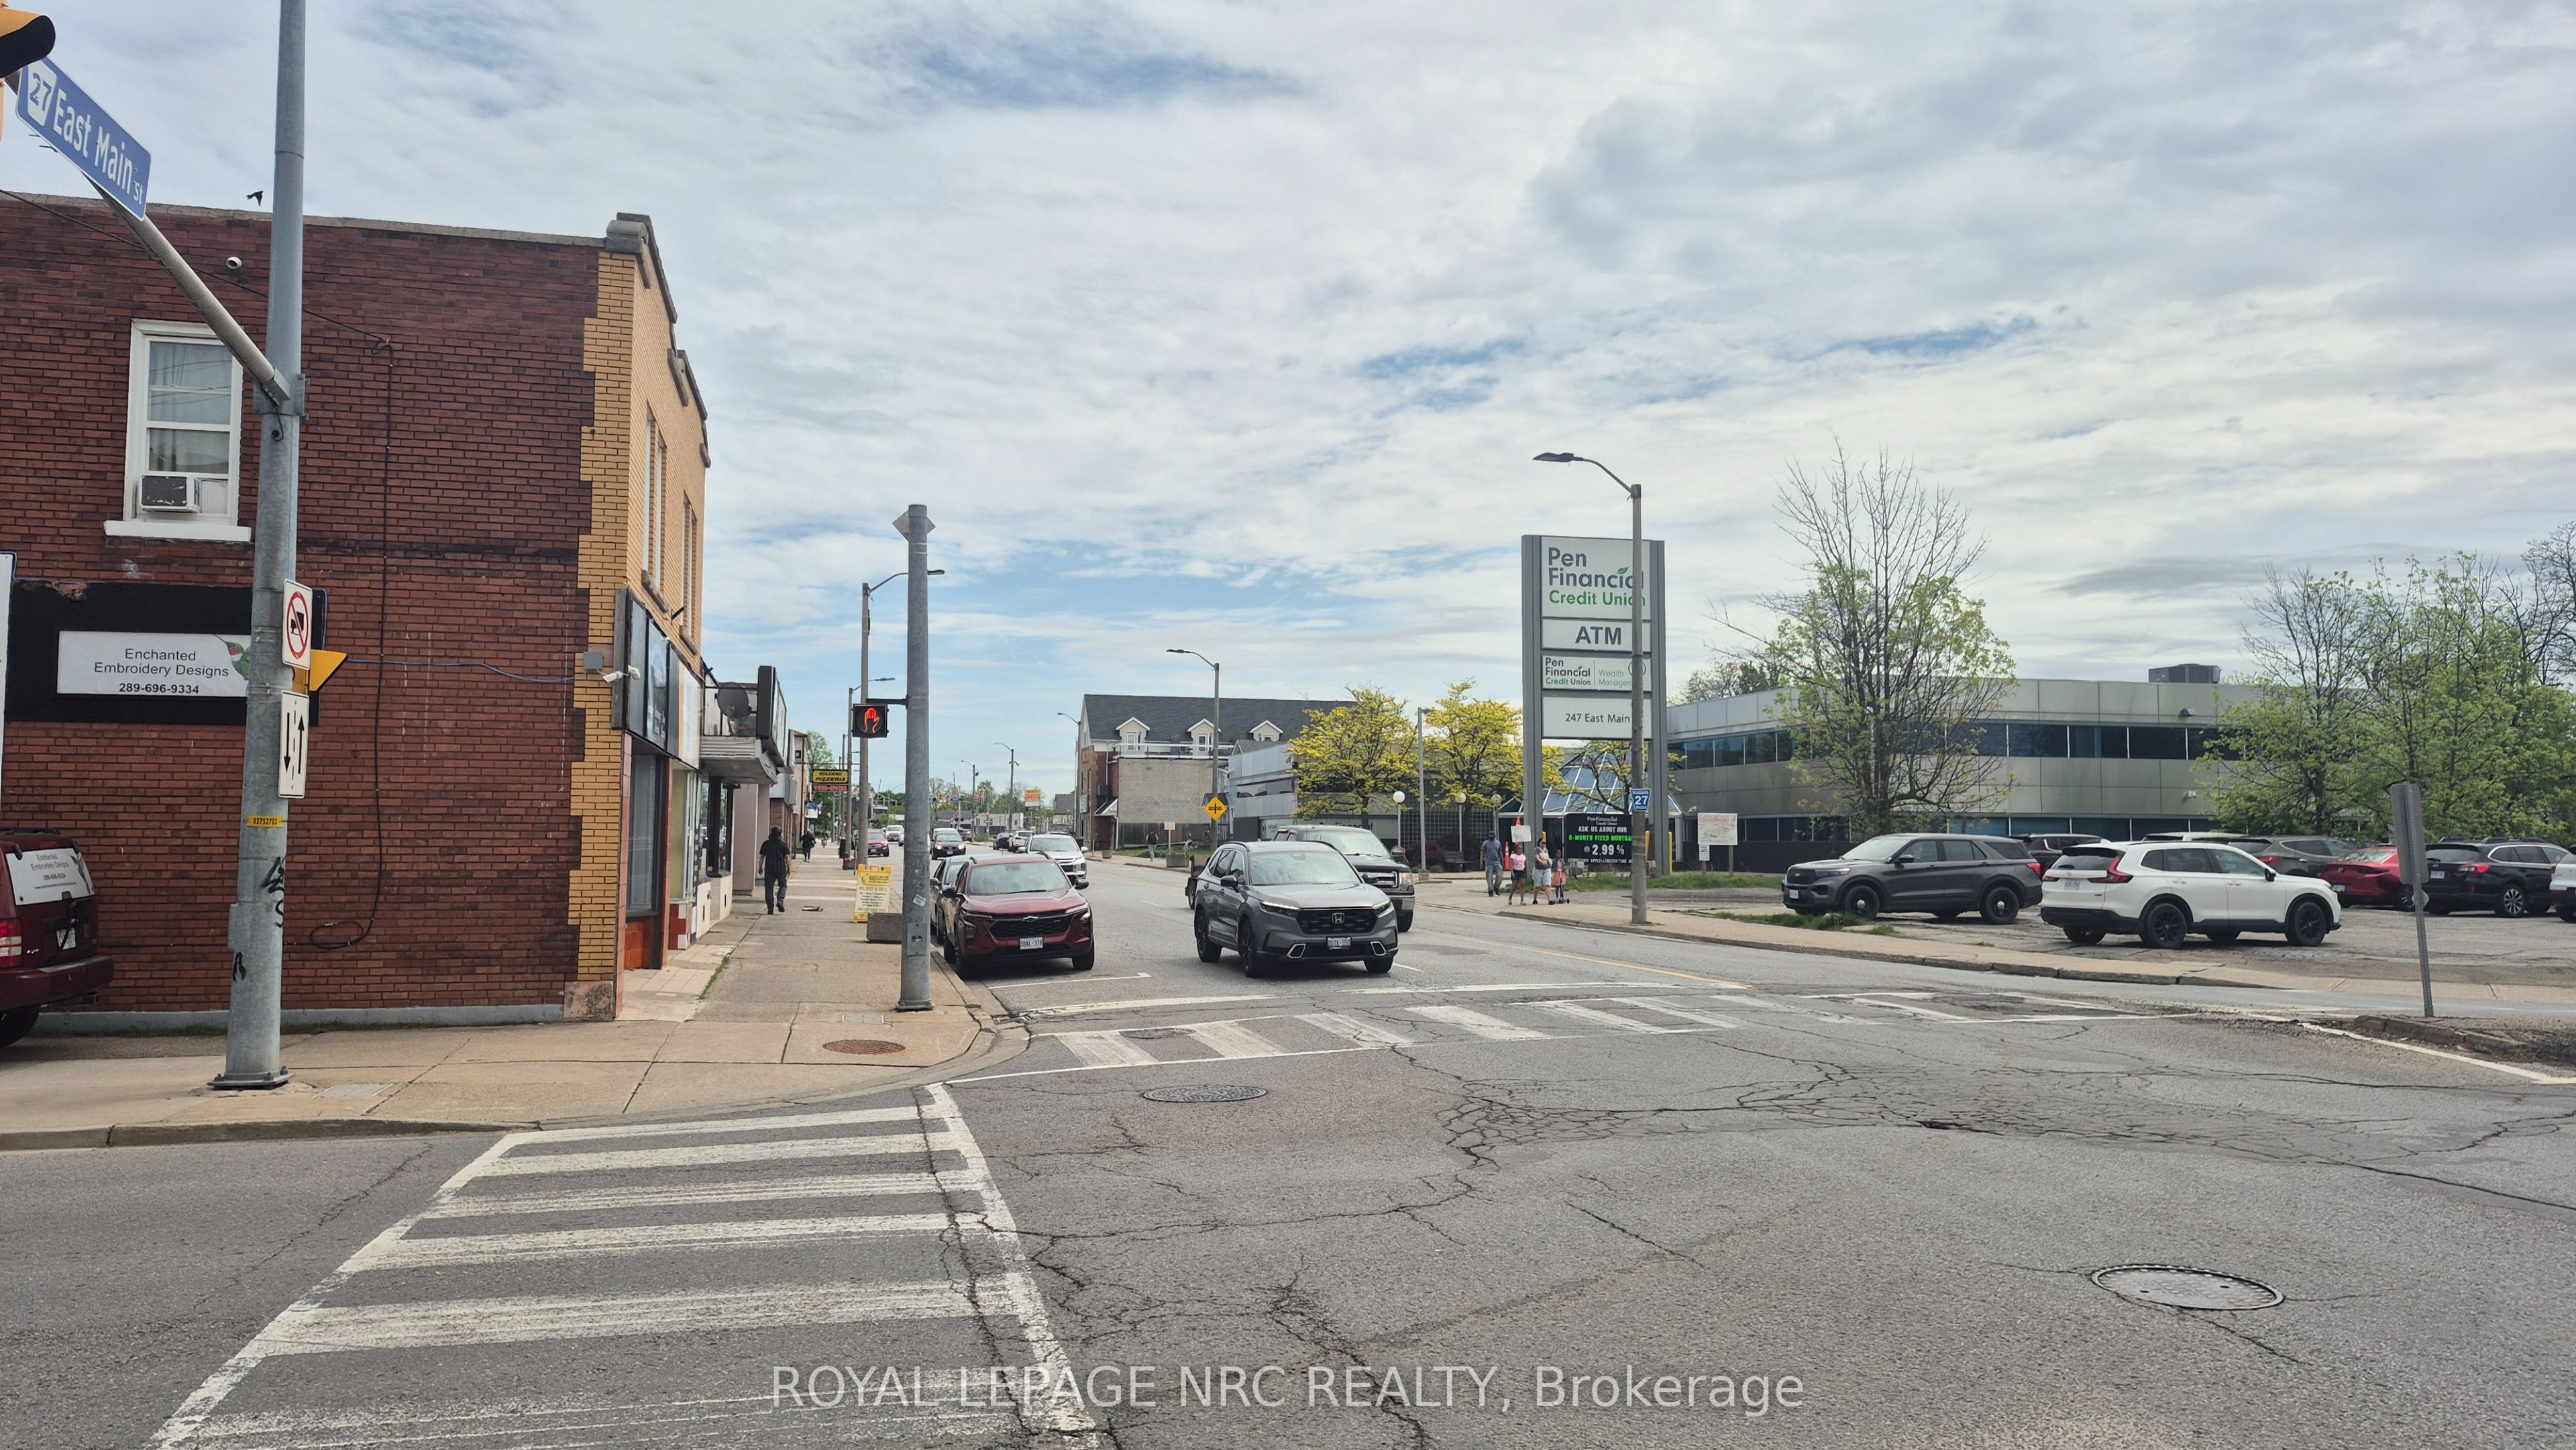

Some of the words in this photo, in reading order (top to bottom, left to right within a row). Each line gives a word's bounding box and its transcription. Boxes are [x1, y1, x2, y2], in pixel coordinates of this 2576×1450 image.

[30, 72, 52, 112] 27
[54, 88, 91, 158] East
[95, 125, 133, 195] Main
[1548, 547, 1587, 567] Pen
[1549, 590, 1597, 605] Credit
[1575, 626, 1621, 645] ATM
[125, 648, 196, 661] Enchanted
[1545, 657, 1564, 667] Pen
[94, 662, 171, 677] Embroidery
[176, 664, 229, 679] Designs
[1545, 667, 1591, 677] Financial
[1598, 668, 1624, 677] Wealth
[119, 682, 199, 694] 289-696-9334
[1598, 678, 1632, 688] Managem
[1565, 713, 1582, 722] 247
[1585, 713, 1604, 723] East
[1607, 714, 1630, 723] Main
[1635, 795, 1648, 805] 27
[1592, 843, 1615, 856] 2.99
